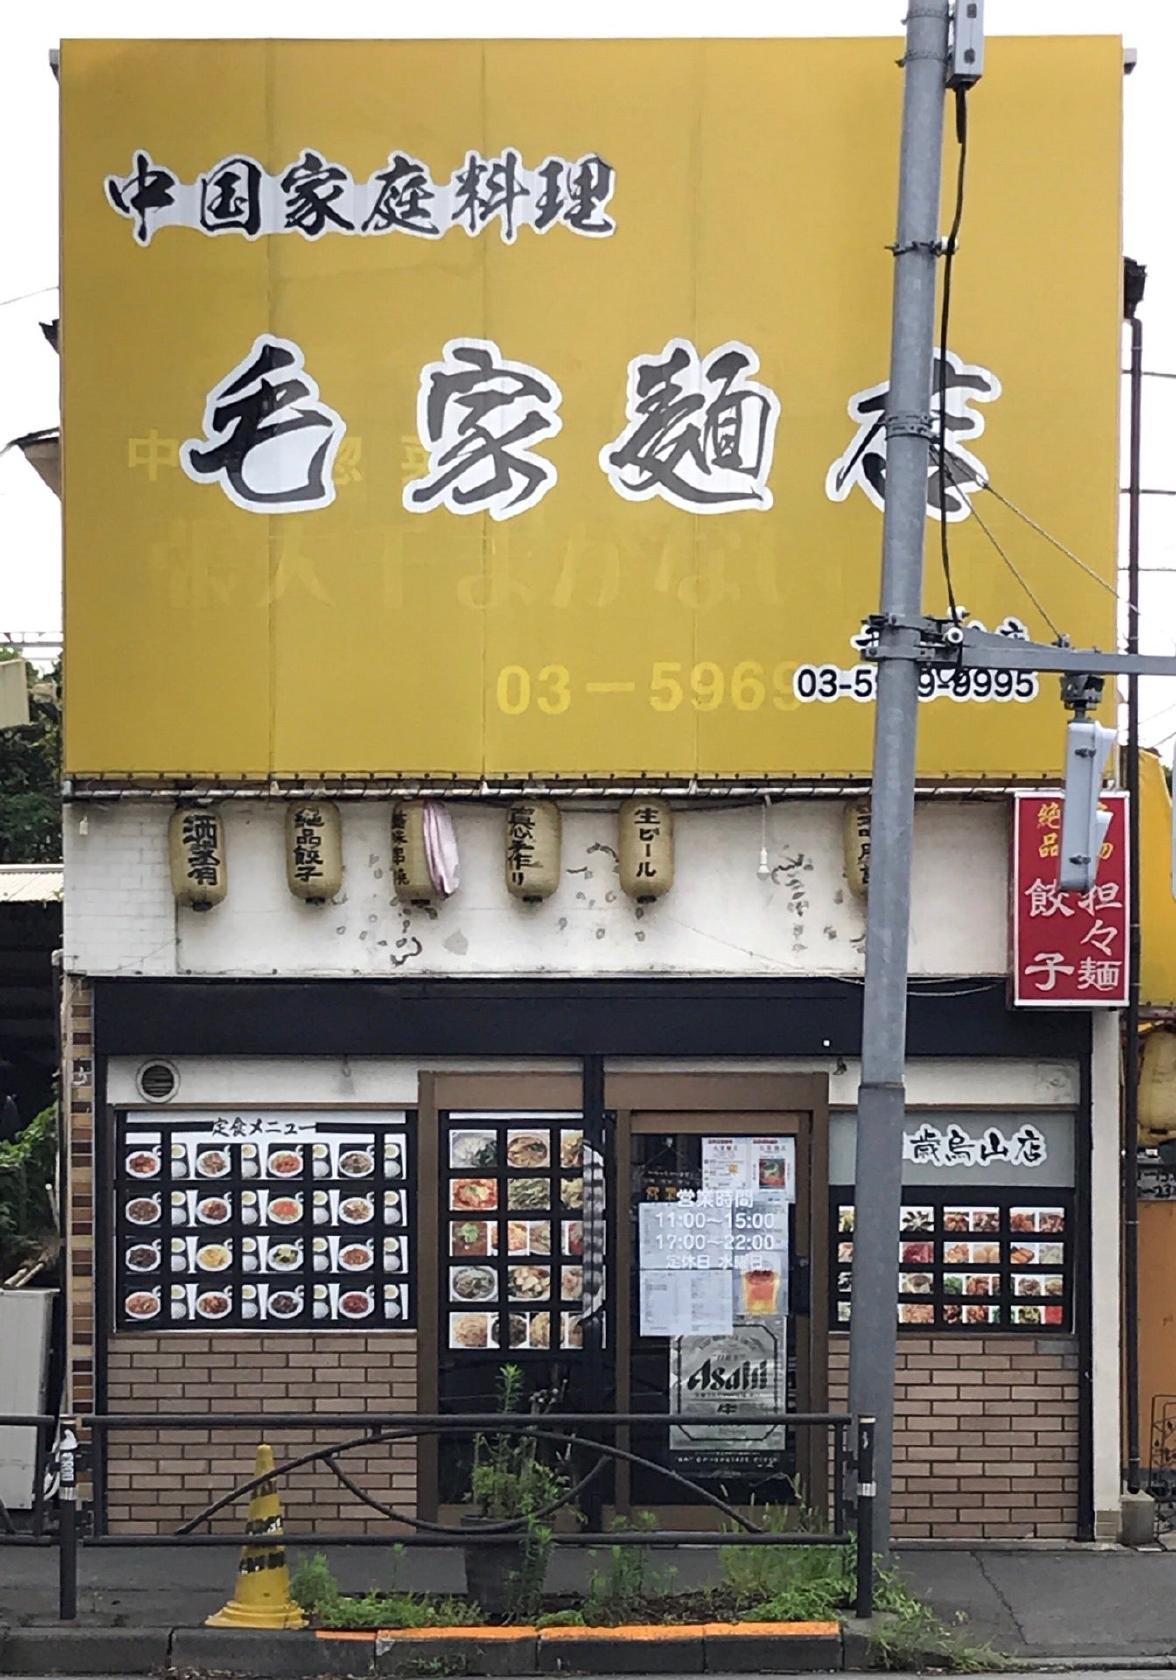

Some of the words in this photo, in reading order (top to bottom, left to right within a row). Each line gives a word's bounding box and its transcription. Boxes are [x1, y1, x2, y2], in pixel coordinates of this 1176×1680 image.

[109, 152, 613, 241] 中国家庭料理
[634, 807, 661, 878] 生ビール
[1025, 878, 1075, 991] 餃子
[212, 1117, 317, 1137] 定食メニュー
[677, 1189, 754, 1208] 営業時間
[666, 1255, 710, 1269] 定休日
[687, 1358, 768, 1391] Asahi
